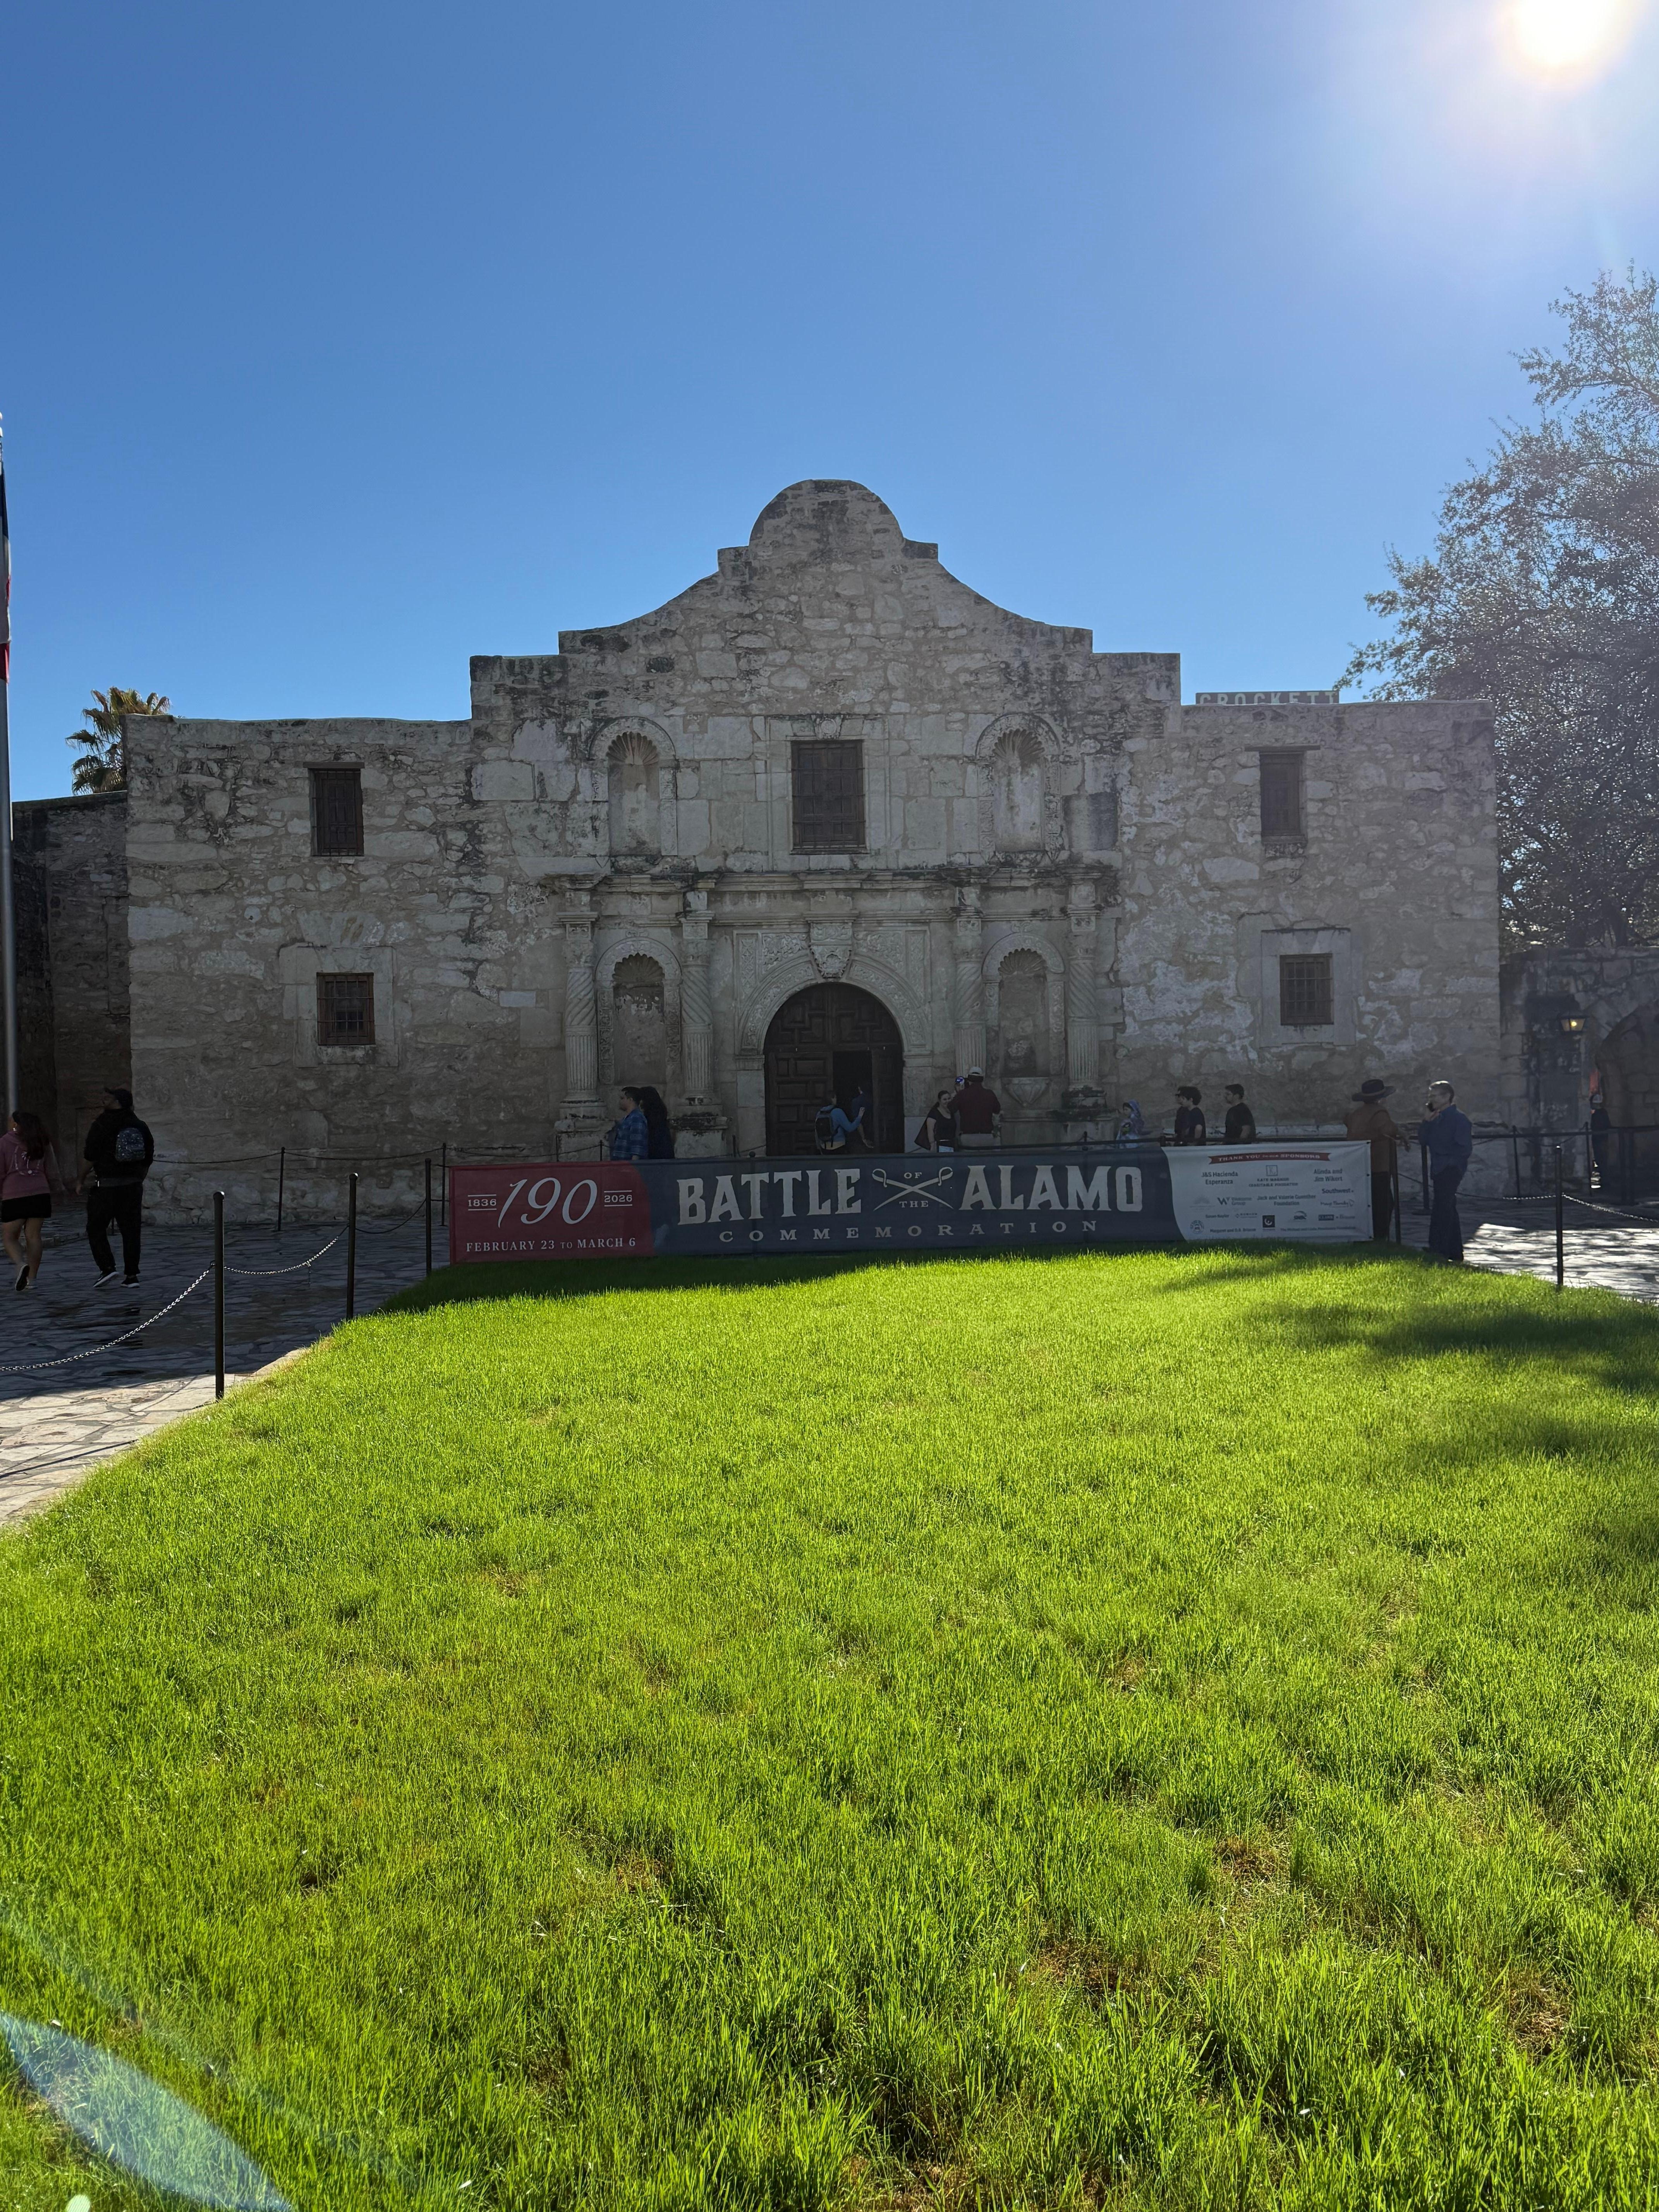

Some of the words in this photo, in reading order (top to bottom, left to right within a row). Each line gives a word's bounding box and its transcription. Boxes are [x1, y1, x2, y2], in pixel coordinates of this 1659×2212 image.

[1200, 692, 1336, 704] CROCKETT
[498, 1177, 598, 1228] 190
[604, 1195, 632, 1203] 2026
[677, 1168, 861, 1225] BATTLE
[899, 1200, 928, 1208] THE
[960, 1165, 1142, 1212] ALAMO
[719, 1220, 1098, 1242] COMMEMORATION
[466, 1241, 535, 1252] FEBRUARY
[541, 1240, 555, 1250] 23
[577, 1238, 623, 1248] MARCH
[629, 1237, 636, 1247] 6
